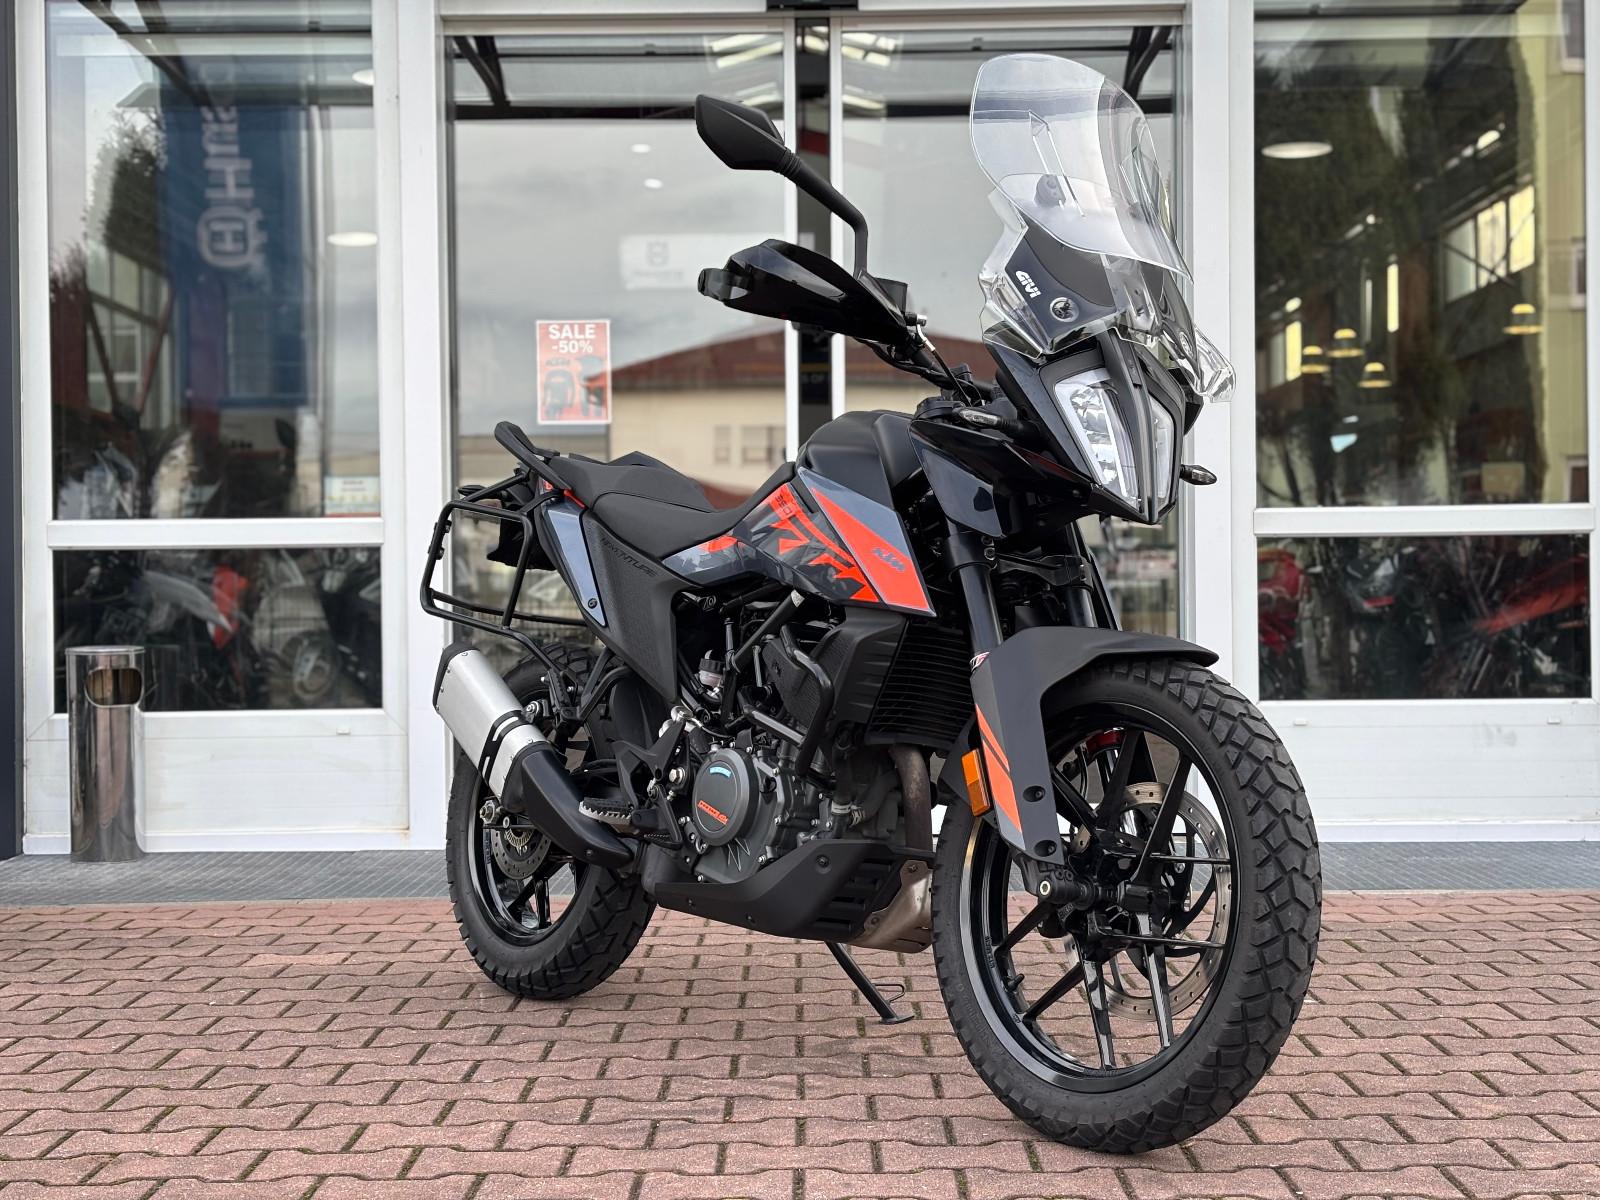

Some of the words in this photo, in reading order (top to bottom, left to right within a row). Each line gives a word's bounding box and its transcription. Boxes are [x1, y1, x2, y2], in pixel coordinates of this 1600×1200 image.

[1015, 270, 1042, 298] GIVI
[548, 323, 597, 340] SALE
[551, 340, 594, 354] -50%
